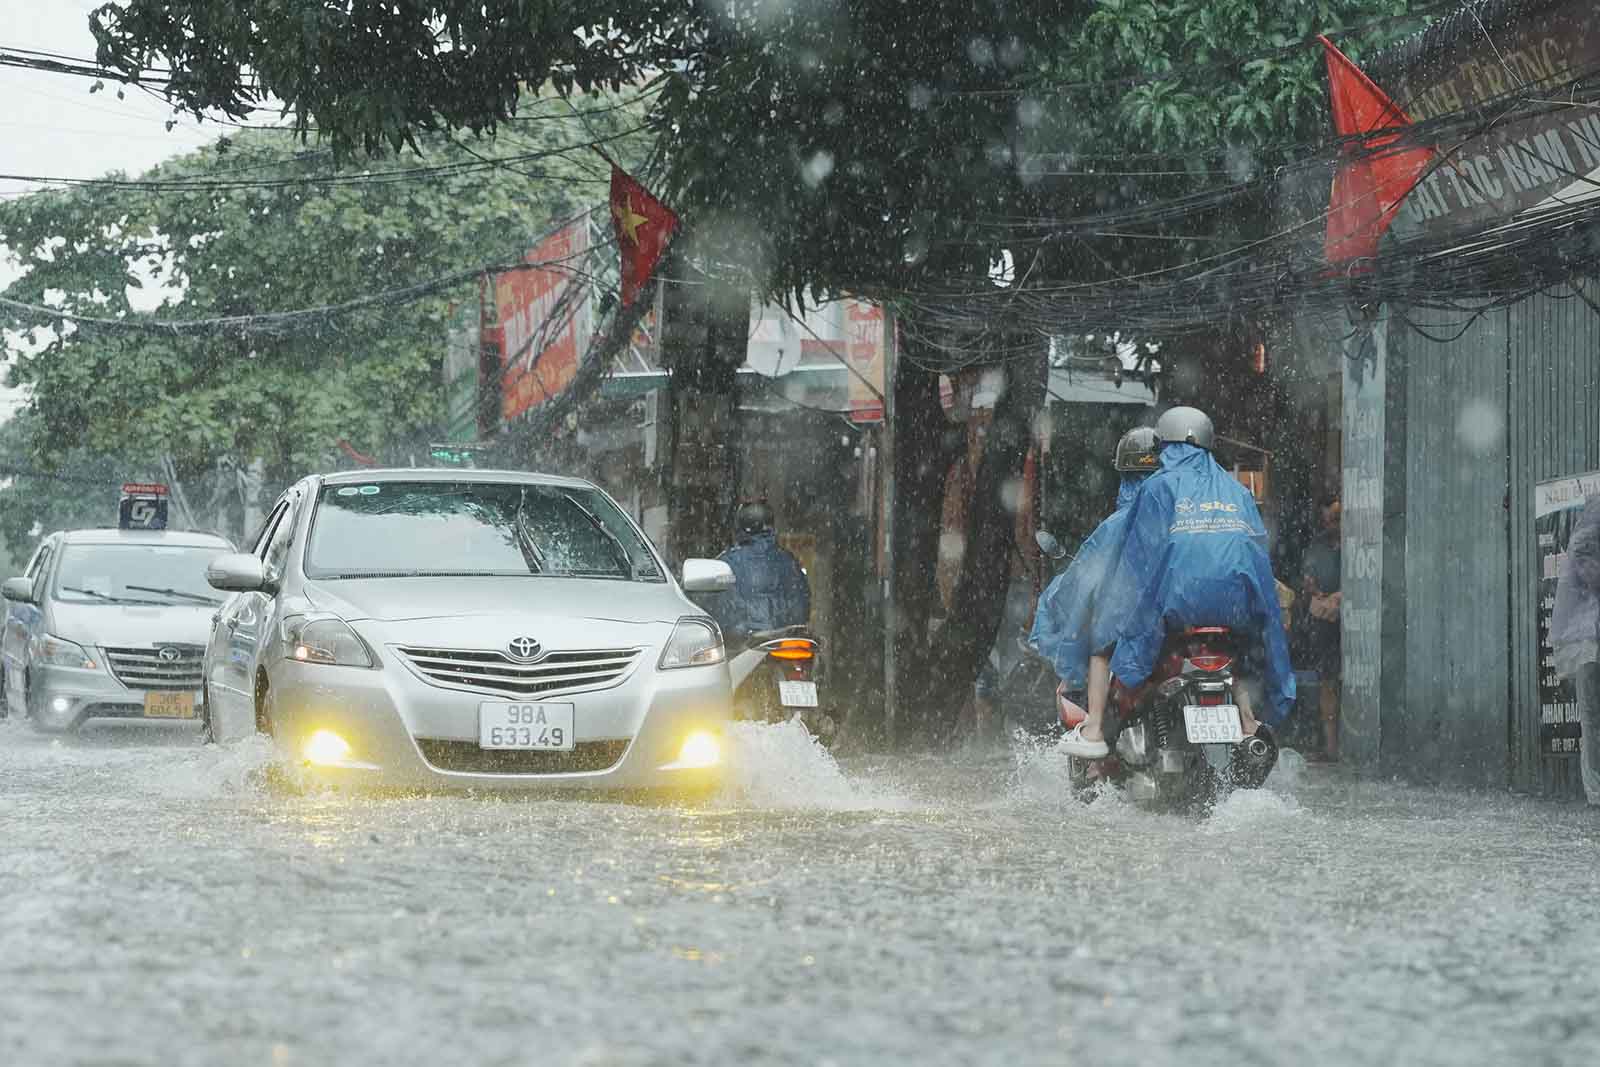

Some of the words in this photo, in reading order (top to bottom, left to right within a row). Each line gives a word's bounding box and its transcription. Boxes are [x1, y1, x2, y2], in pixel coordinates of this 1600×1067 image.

[1496, 129, 1577, 193] NAM
[508, 705, 548, 724] 98A
[491, 728, 563, 746] 633.49
